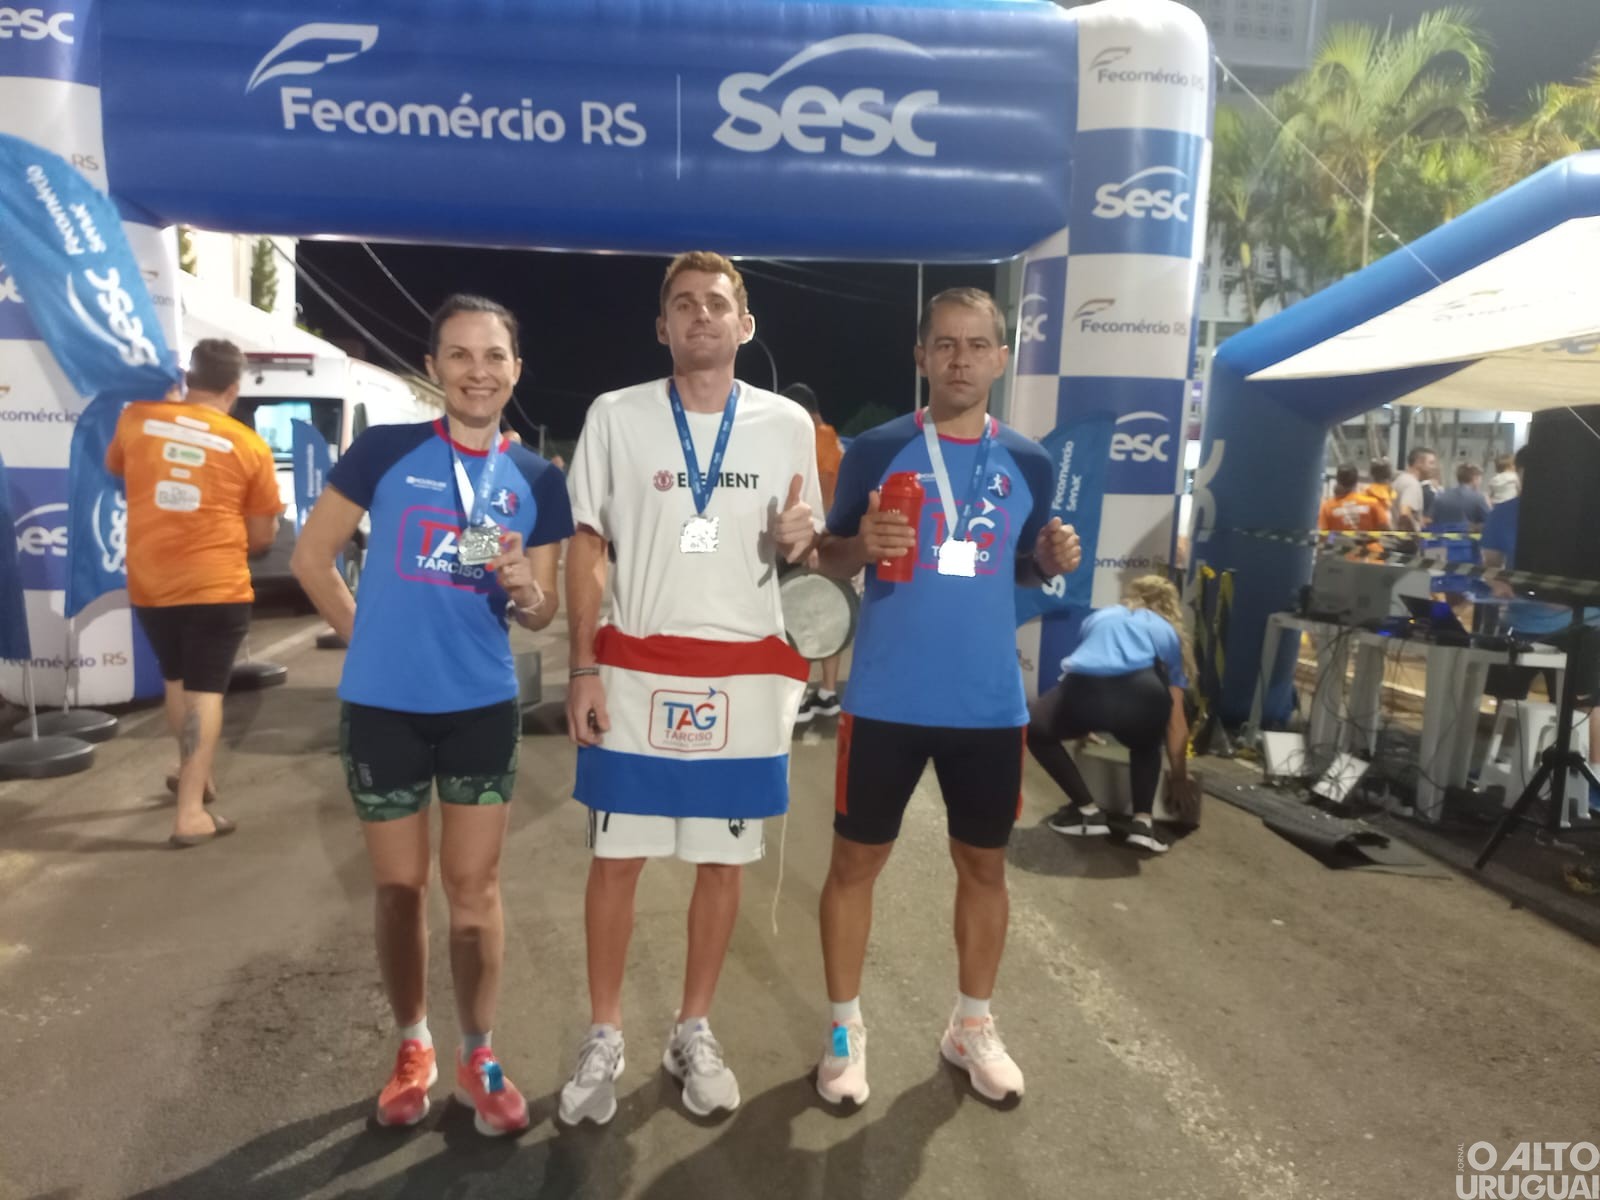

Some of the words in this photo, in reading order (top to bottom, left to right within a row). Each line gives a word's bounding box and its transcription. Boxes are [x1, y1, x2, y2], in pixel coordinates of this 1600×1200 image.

[1098, 67, 1189, 87] Fecomércio
[280, 86, 566, 142] Fecomércio
[582, 101, 647, 147] RS
[713, 72, 940, 157] Sesc
[1091, 183, 1191, 222] Sesc
[83, 266, 161, 367] Sesc
[1081, 317, 1171, 335] Fecomércio
[0, 406, 82, 424] comércio
[417, 519, 463, 558] TA
[929, 512, 996, 551] TG
[415, 555, 485, 580] TARCISO
[1094, 553, 1150, 569] omércio
[101, 651, 129, 668] RS
[661, 701, 718, 731] TAG
[663, 729, 713, 742] TARCISO
